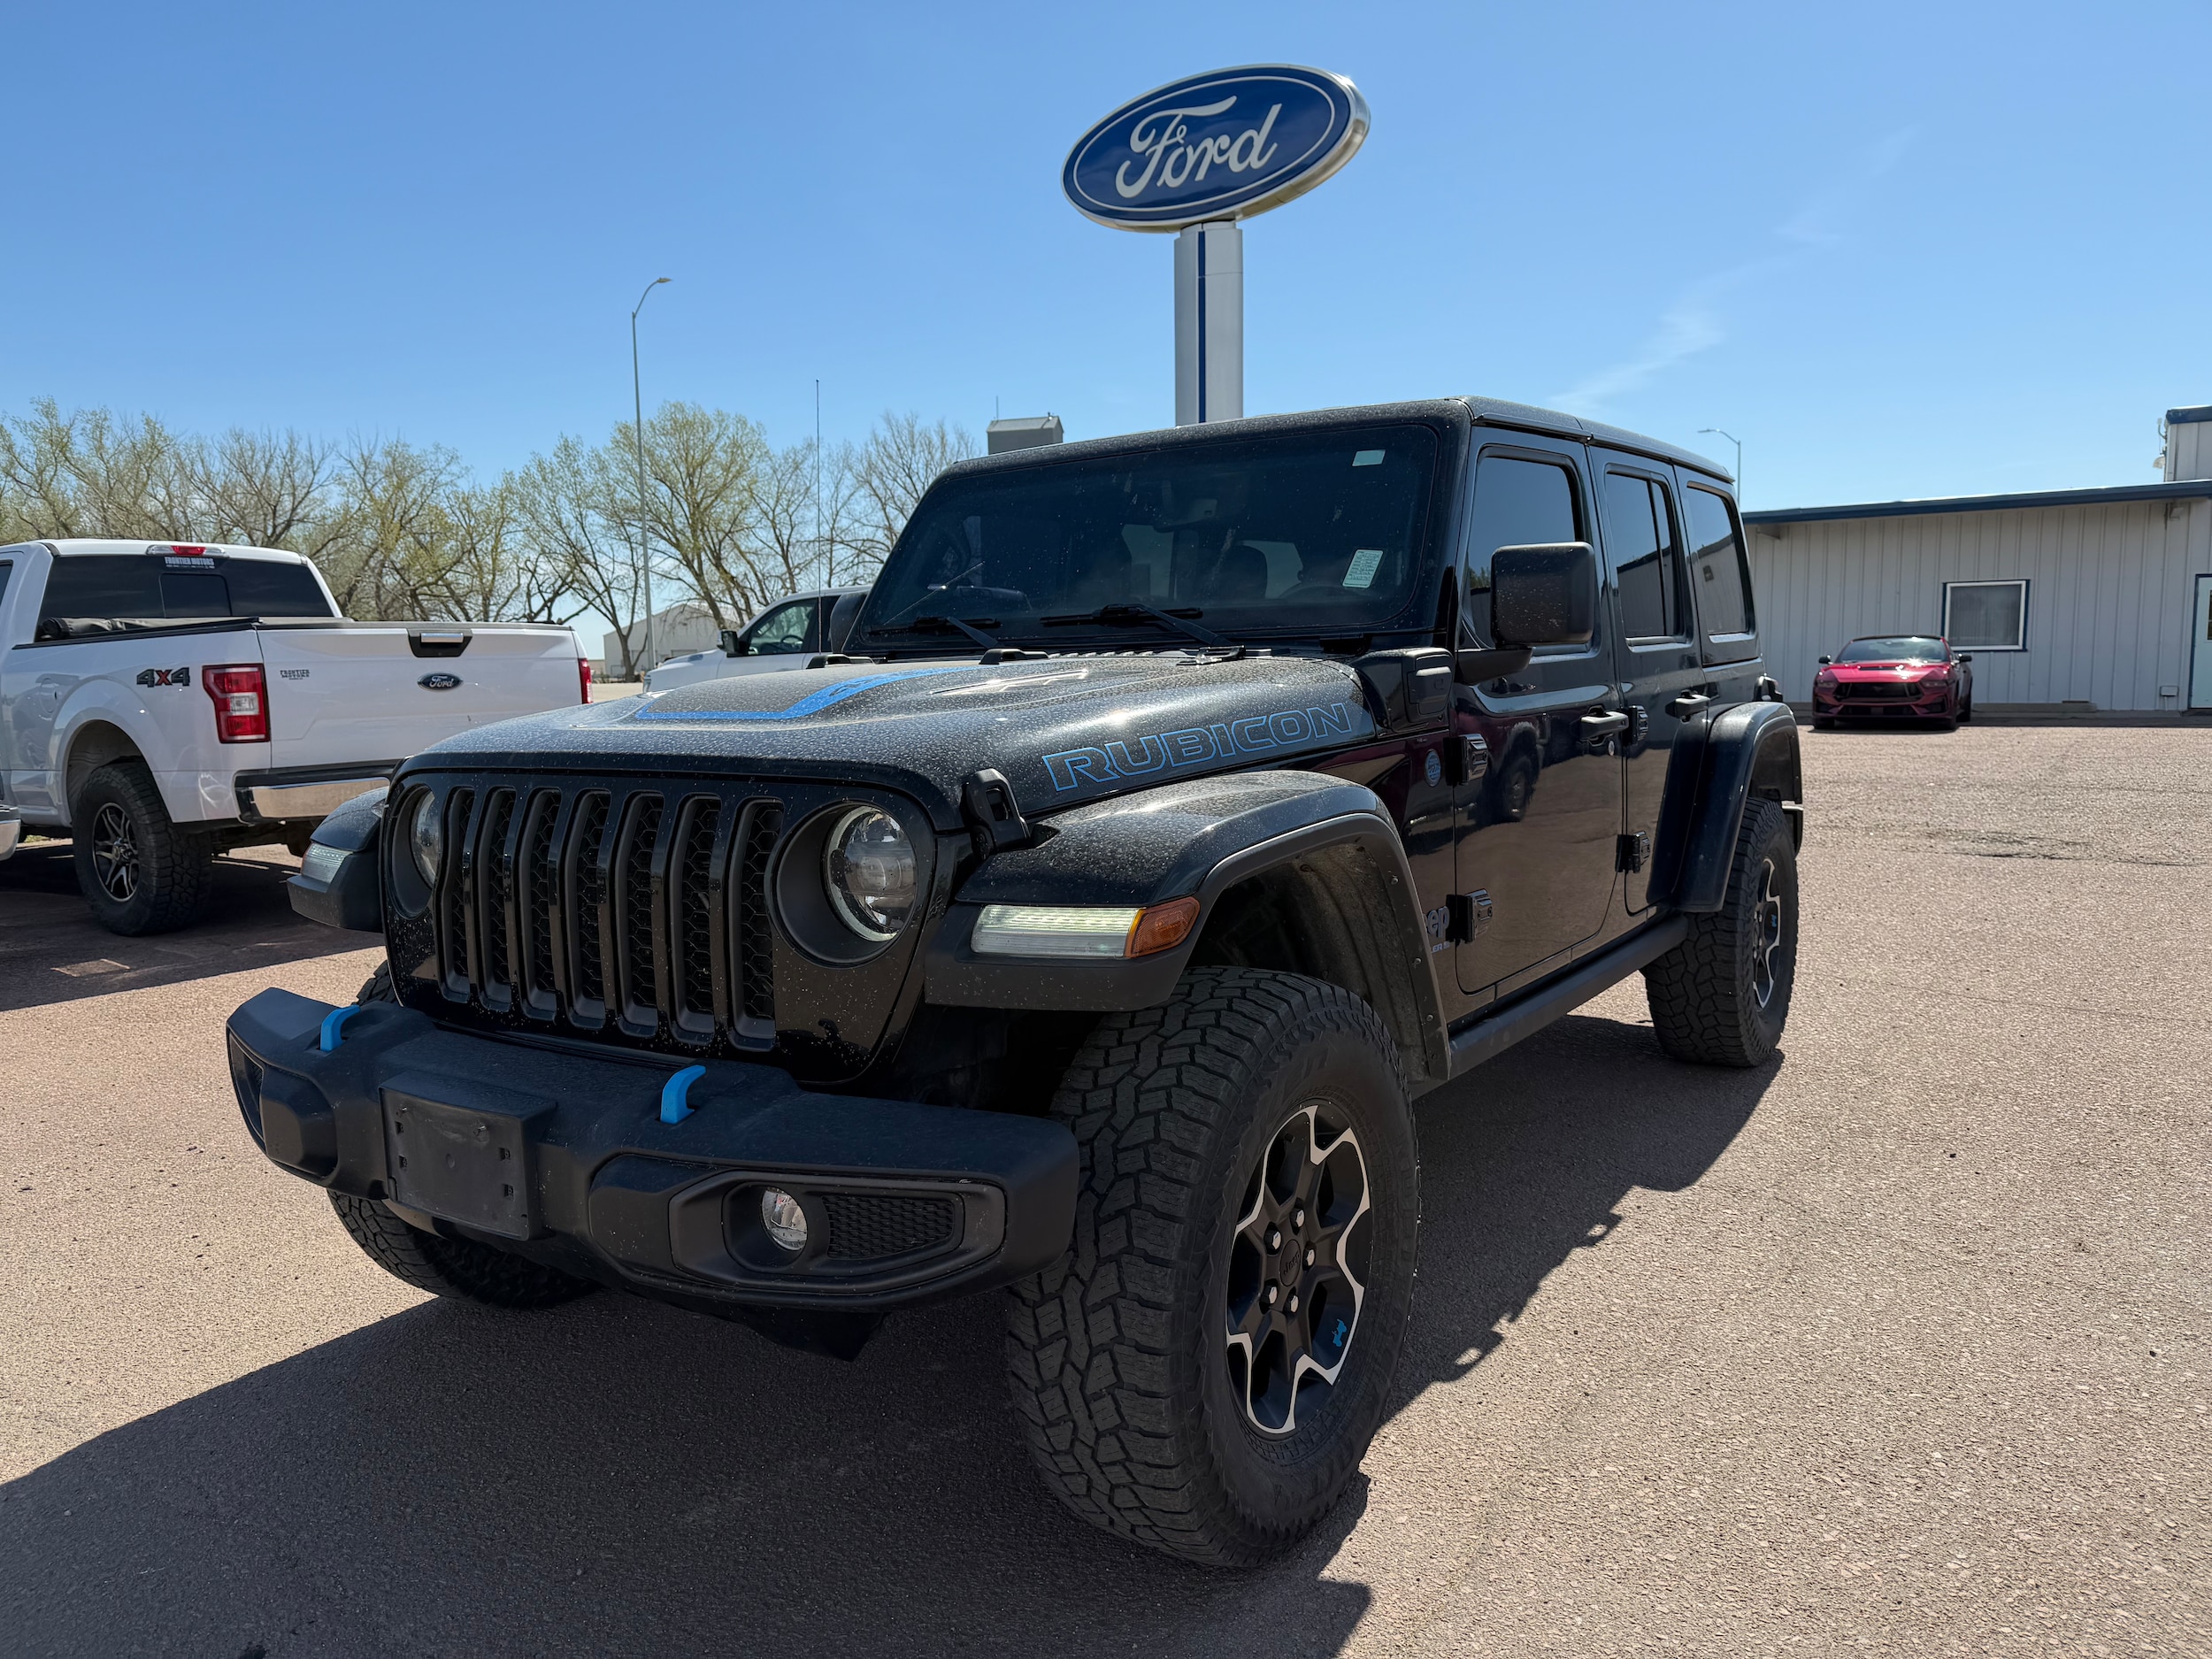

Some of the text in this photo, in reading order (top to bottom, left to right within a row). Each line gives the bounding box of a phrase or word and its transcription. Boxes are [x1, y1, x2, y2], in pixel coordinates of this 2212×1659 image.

[1116, 96, 1282, 198] Ford
[429, 675, 454, 687] Ford
[1042, 703, 1352, 791] RUBICON
[1283, 1250, 1300, 1275] Jeep
